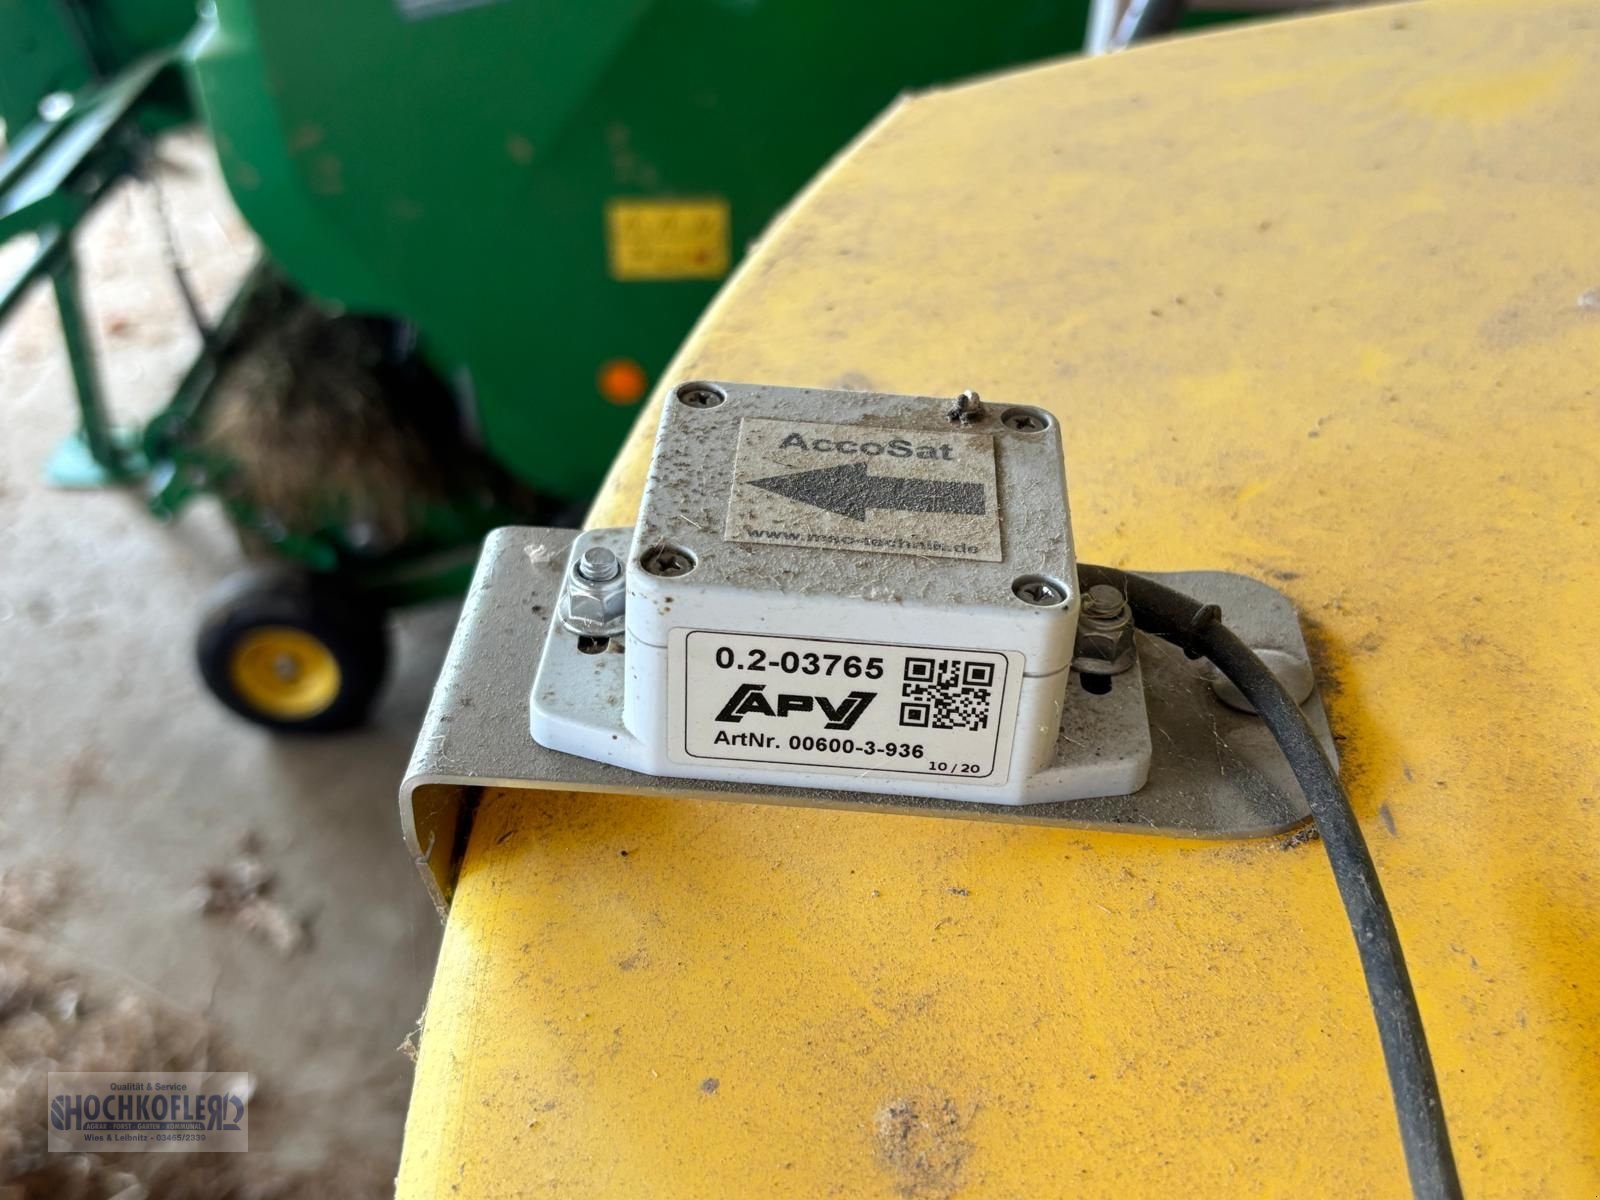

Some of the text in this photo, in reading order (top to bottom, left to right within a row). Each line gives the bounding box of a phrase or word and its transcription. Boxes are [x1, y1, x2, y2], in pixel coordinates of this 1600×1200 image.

[779, 432, 954, 460] AccoSat
[715, 646, 884, 680] 0.2-03765
[714, 683, 878, 731] APV
[714, 731, 924, 759] ArtNr. 00600-3-936
[928, 761, 948, 772] 10
[961, 764, 981, 774] 20
